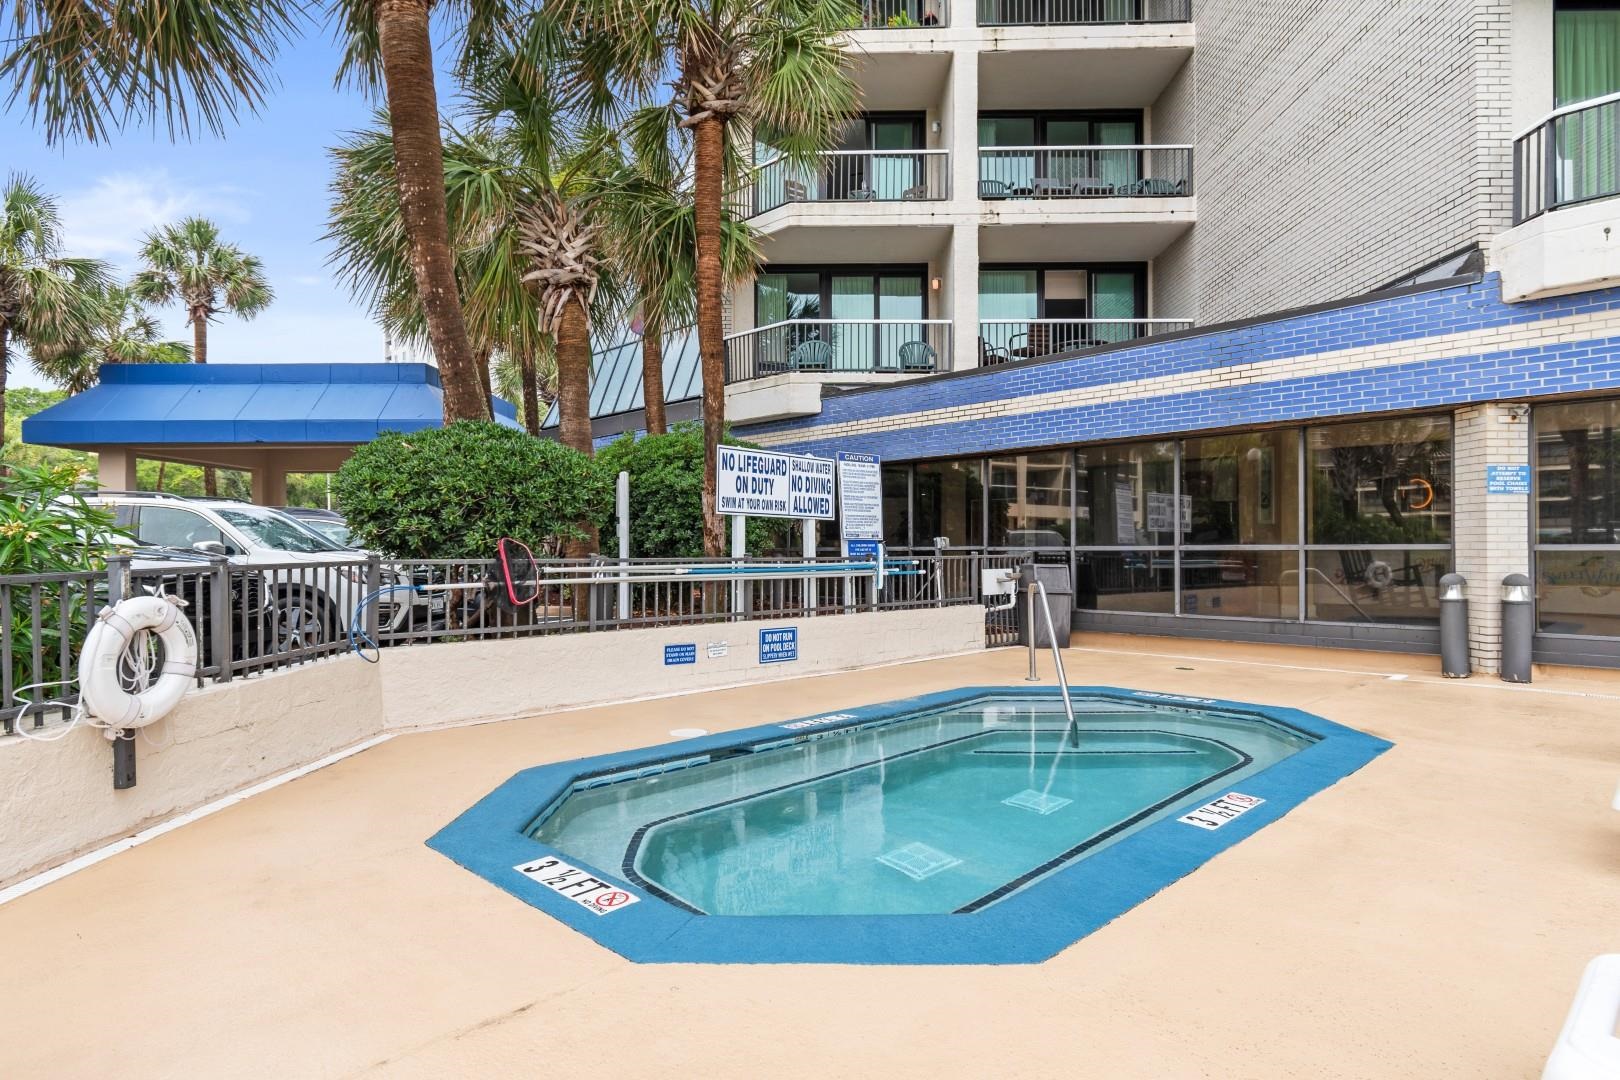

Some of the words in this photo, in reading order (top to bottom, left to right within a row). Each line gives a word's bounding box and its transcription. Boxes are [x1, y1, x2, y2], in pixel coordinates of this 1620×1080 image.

[721, 452, 735, 471] NO
[738, 455, 787, 476] LIFEGUARD
[844, 454, 874, 462] CAUTION
[792, 460, 815, 473] SHALLOW
[815, 462, 831, 475] WATER
[735, 475, 749, 494] ON
[751, 477, 775, 495] DUTY
[791, 475, 803, 492] NO
[805, 476, 832, 495] DIVING
[721, 496, 737, 508] SWIM
[737, 497, 745, 509] AT
[746, 498, 761, 510] YOUR
[761, 499, 774, 511] OWN
[774, 500, 787, 512] RISK
[793, 496, 830, 515] ALLOWED
[765, 634, 773, 643] DO
[773, 633, 782, 642] NOT
[782, 631, 793, 641] RUN
[762, 643, 770, 653] ON
[770, 643, 782, 652] POOL
[782, 642, 795, 651] DECK
[762, 652, 778, 660] SLIPPERY
[1185, 815, 1219, 826] 3
[1210, 799, 1249, 813] FT
[523, 860, 559, 873] 3
[558, 877, 612, 898] FT
[588, 901, 608, 914] DIVING
